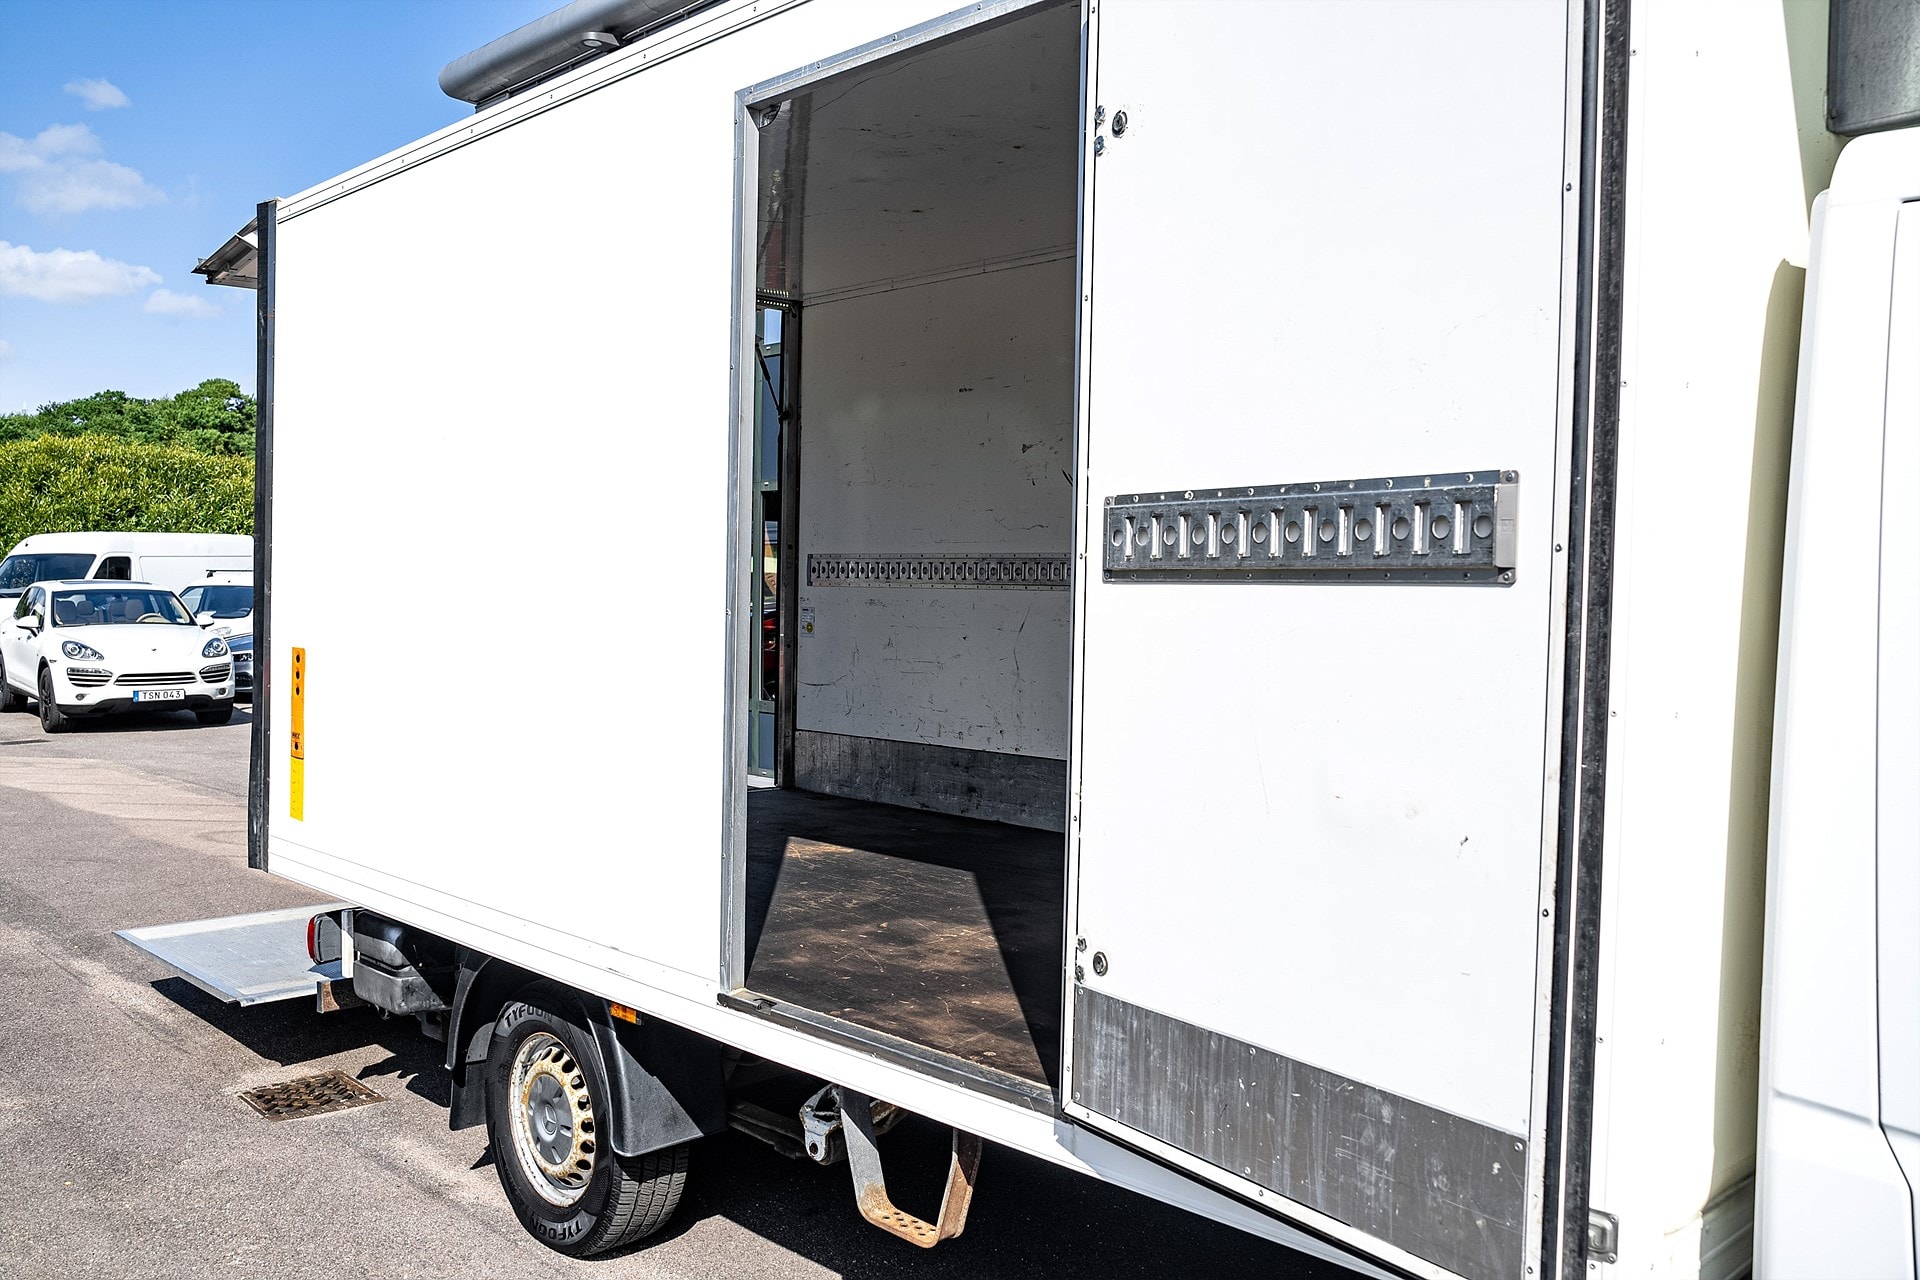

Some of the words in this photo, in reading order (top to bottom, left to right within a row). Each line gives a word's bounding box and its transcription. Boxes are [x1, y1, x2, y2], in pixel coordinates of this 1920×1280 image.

[142, 691, 161, 700] TSN
[162, 690, 181, 699] 043
[504, 1004, 553, 1027] TYFOON
